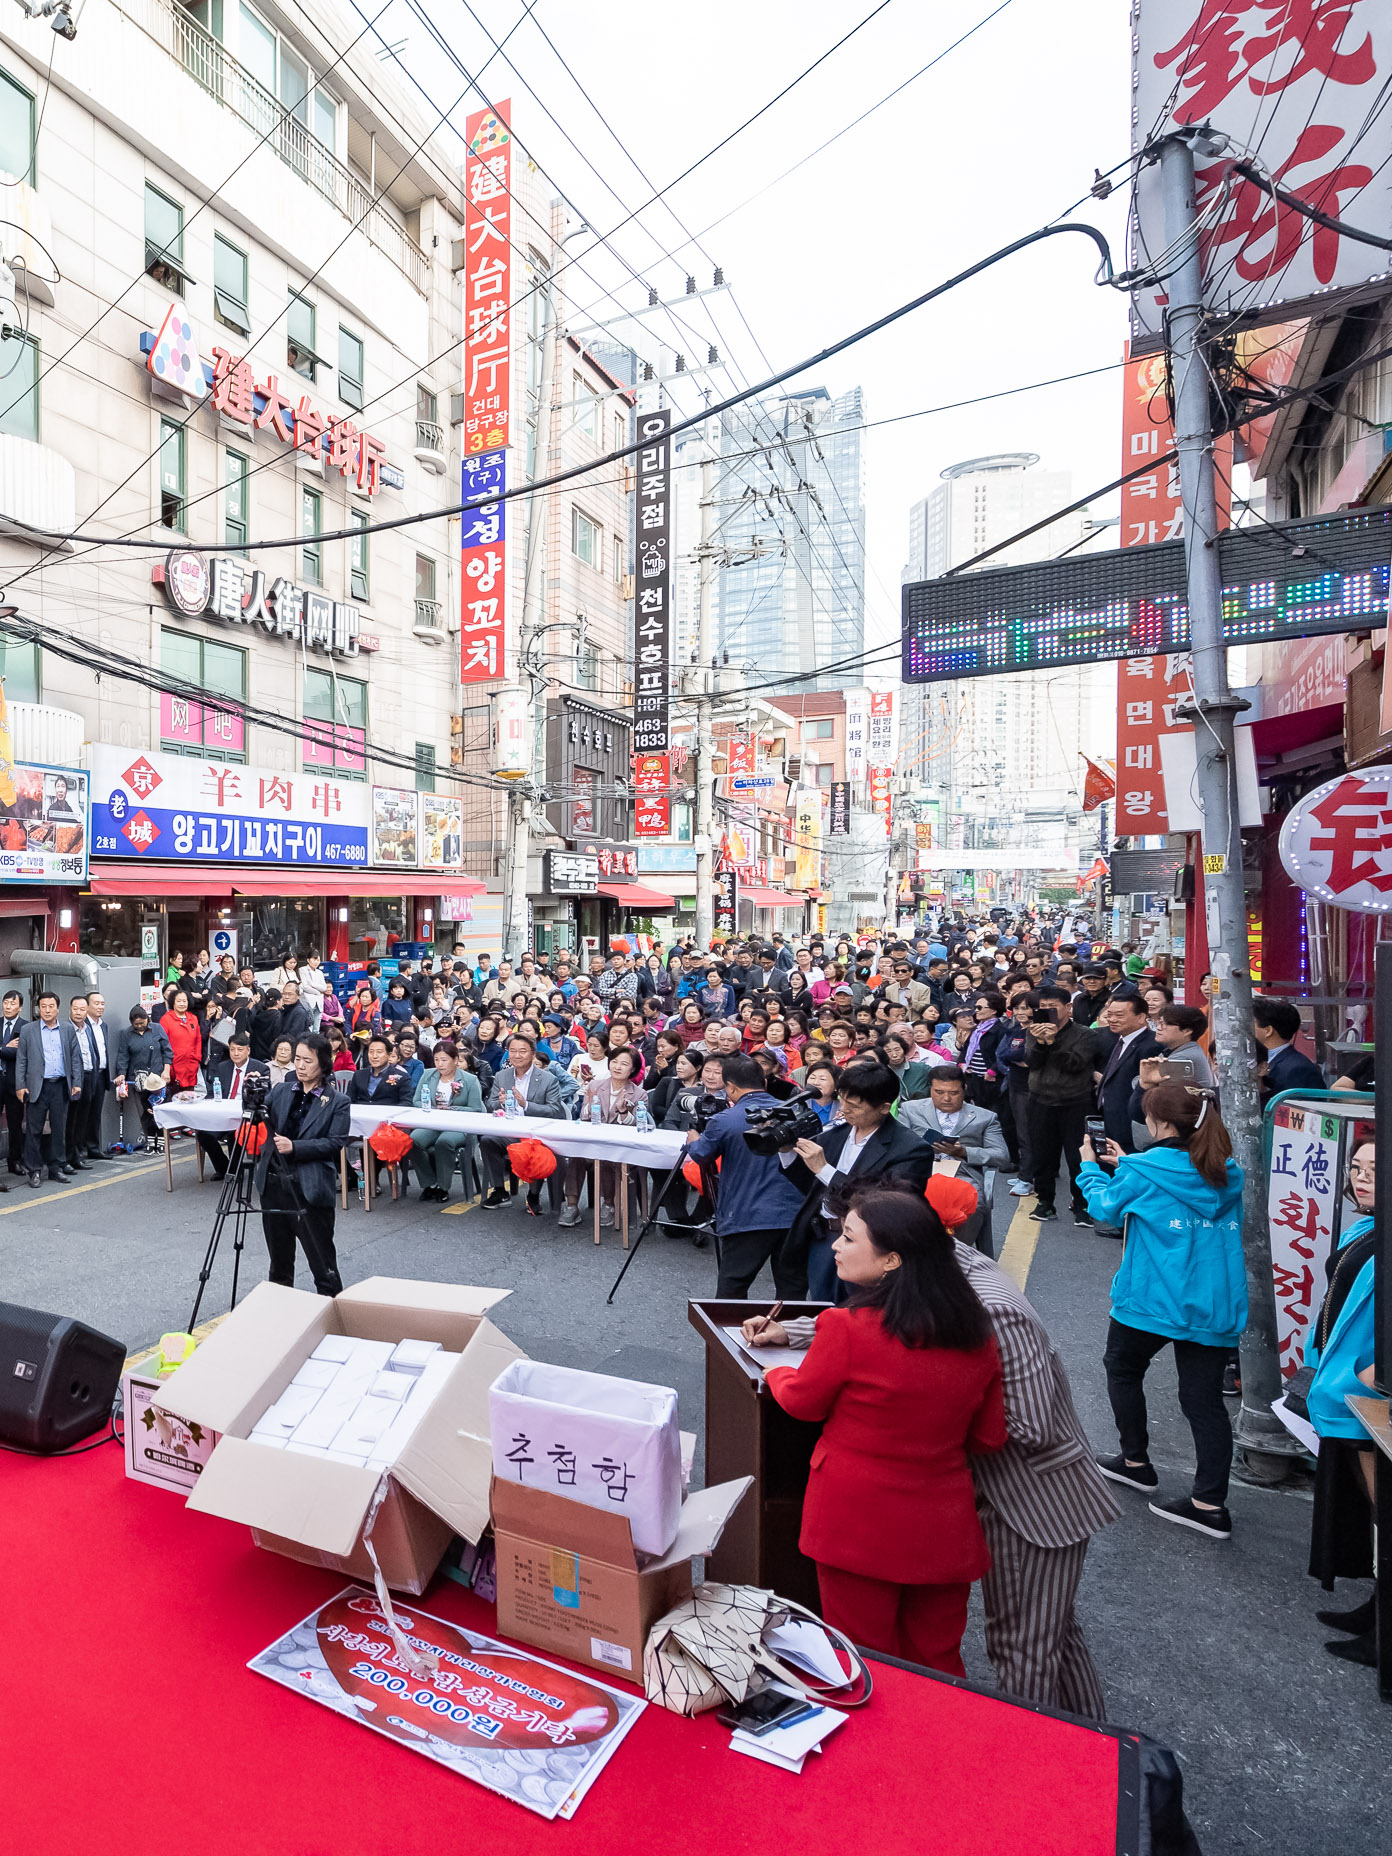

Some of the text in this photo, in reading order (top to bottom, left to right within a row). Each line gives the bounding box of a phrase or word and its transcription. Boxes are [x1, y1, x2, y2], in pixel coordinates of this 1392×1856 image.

[469, 155, 510, 395] 建大台球厅
[210, 346, 388, 496] 建大台球厅
[471, 394, 501, 416] 건대
[465, 409, 510, 434] 당구장
[469, 429, 506, 452] 3층
[462, 453, 506, 473] 원조
[468, 469, 503, 489] (구)
[638, 417, 667, 528] 요리주점
[209, 557, 360, 659] 唐人街网吧
[463, 551, 503, 675] 양꼬치
[638, 585, 666, 696] 천수호프
[634, 718, 668, 733] 463-
[634, 732, 667, 748] 1833
[130, 765, 156, 792] 京
[200, 766, 342, 818] 羊肉串
[110, 794, 128, 818] 老
[95, 835, 118, 850] 2호점
[128, 819, 153, 845] 城
[172, 814, 322, 861] 양고기꼬치구이
[324, 844, 366, 861] 467-6880
[1271, 1142, 1331, 1195] 正德
[504, 1432, 637, 1503] 추첨함
[317, 1624, 390, 1661] 사랑의
[349, 1660, 504, 1740] 200,000원
